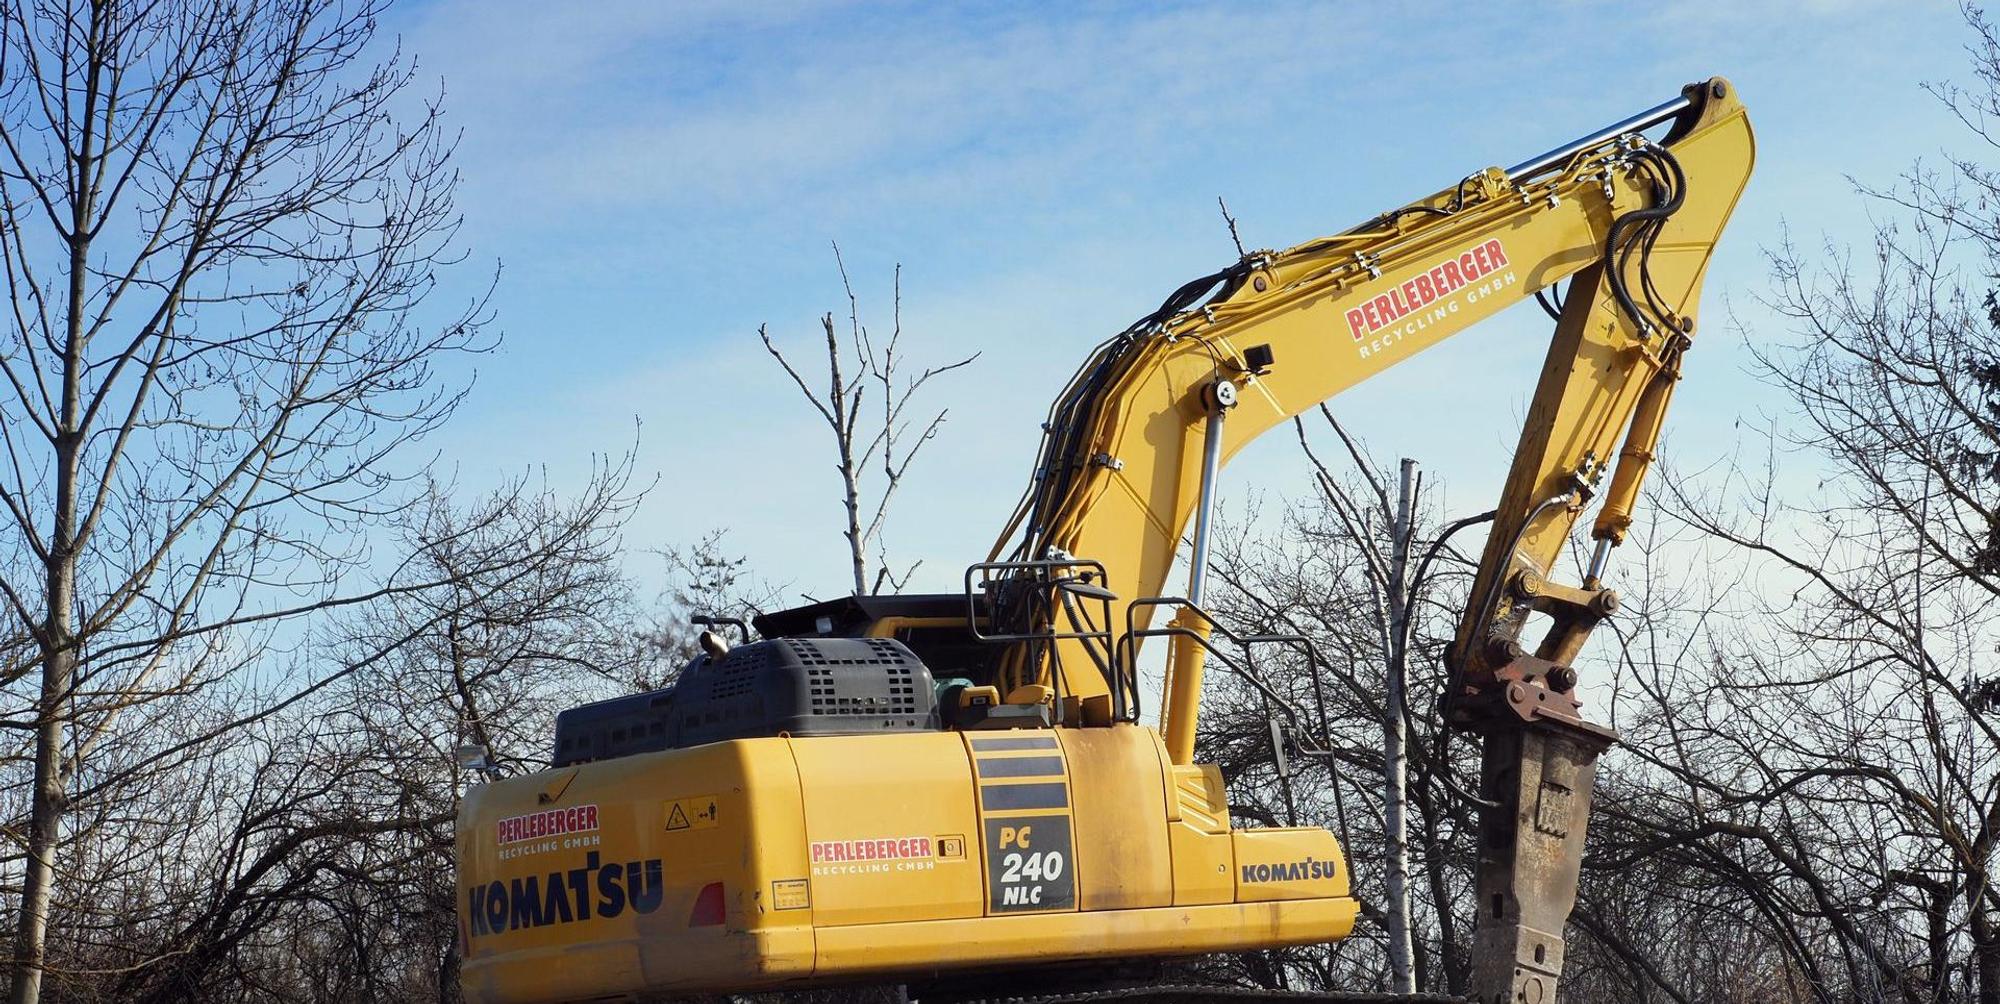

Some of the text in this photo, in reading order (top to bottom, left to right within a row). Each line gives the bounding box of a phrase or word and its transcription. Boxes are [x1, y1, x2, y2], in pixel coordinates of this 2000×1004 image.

[1345, 238, 1509, 341] PERLEBERGER
[1359, 271, 1516, 358] RECYCLING GMBH
[498, 805, 599, 845] PERLEBERGER
[1000, 826, 1031, 849] PC
[499, 835, 600, 860] RECYCLING GMBH
[811, 837, 932, 863] PERLEBERGER
[813, 864, 890, 875] RECYCLING
[1000, 851, 1064, 883] 240
[1241, 856, 1335, 883] KOMATSU
[468, 851, 663, 938] KOMATSU
[1003, 885, 1042, 907] NLC
